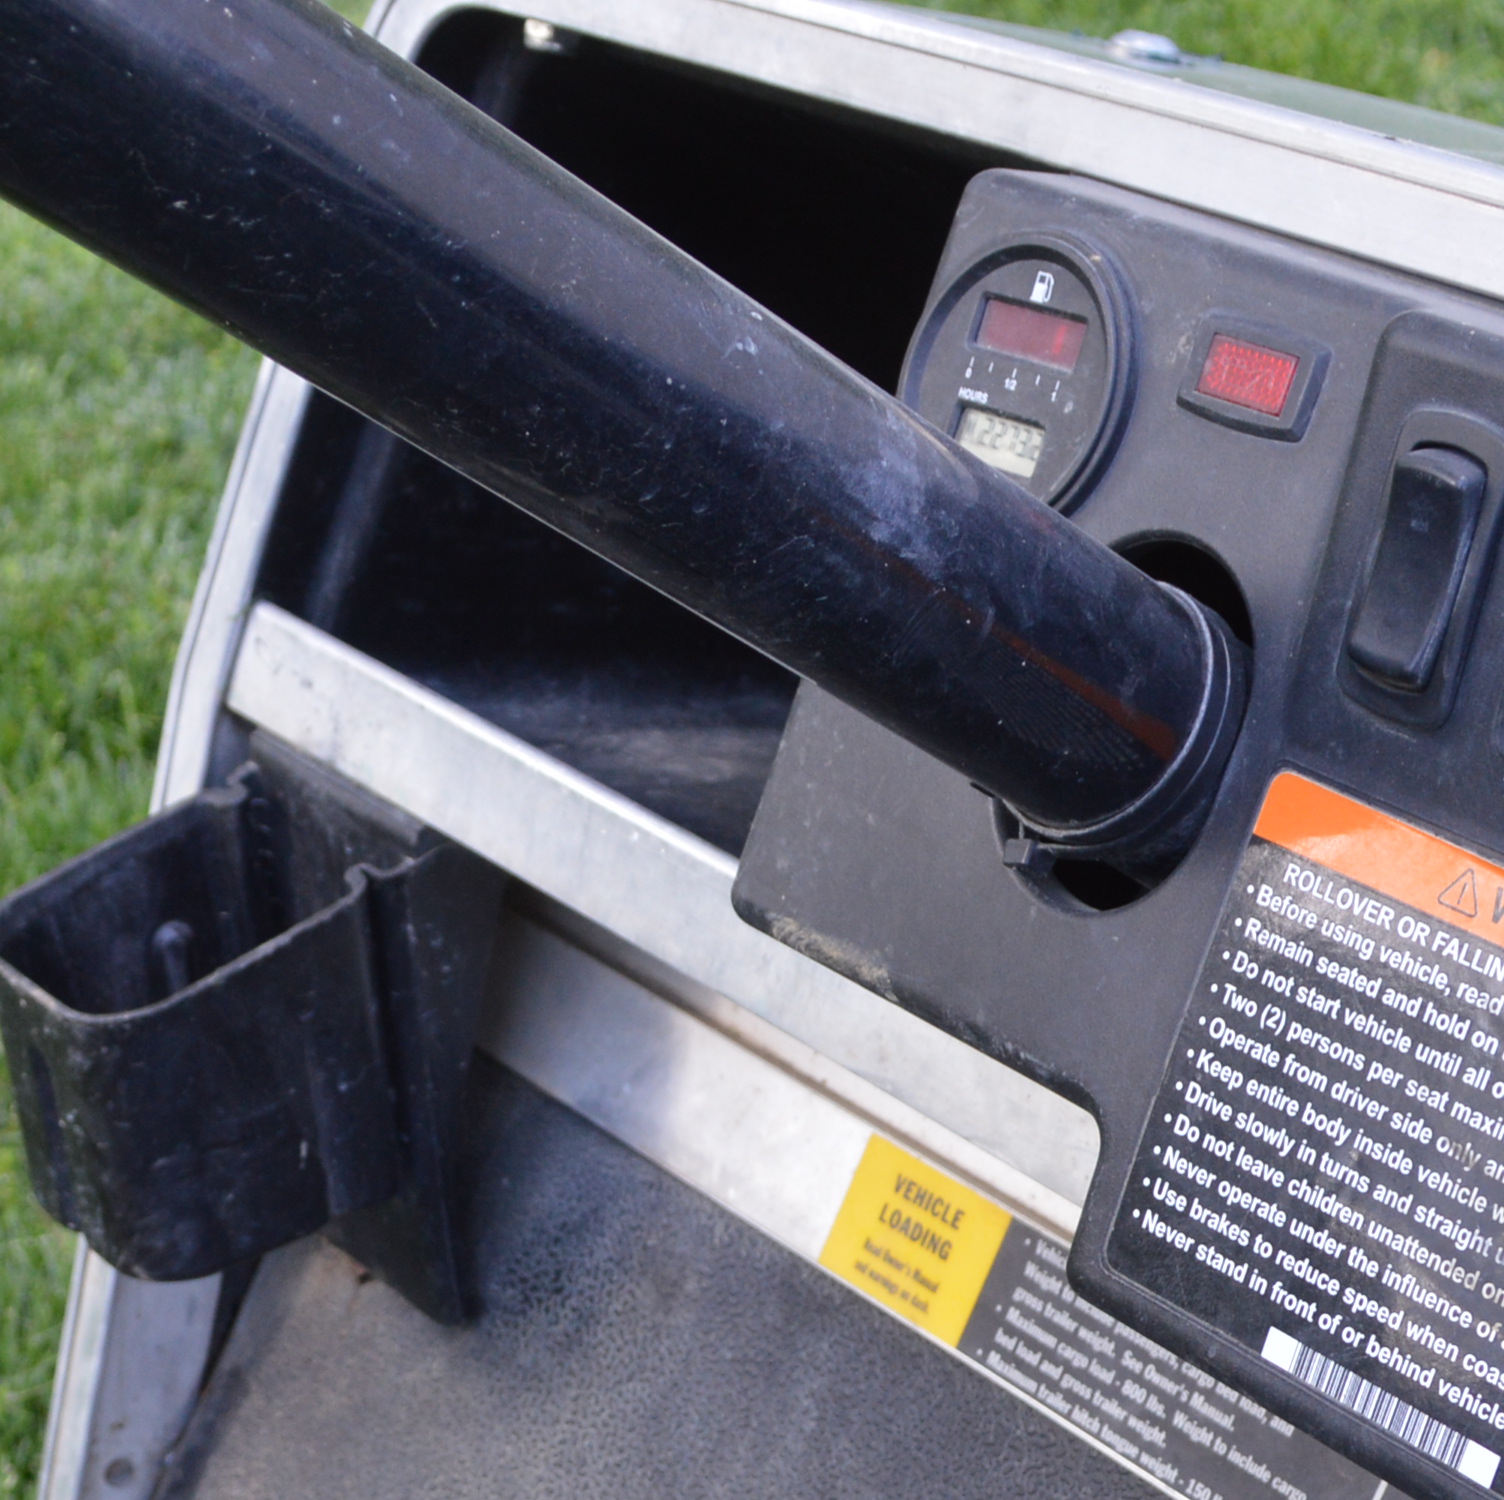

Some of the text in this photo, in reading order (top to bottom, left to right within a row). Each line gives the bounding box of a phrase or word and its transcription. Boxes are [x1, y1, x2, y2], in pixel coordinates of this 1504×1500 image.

[958, 387, 988, 403] HOURS
[1255, 883, 1317, 929] Before
[1320, 916, 1375, 960] using
[1379, 944, 1450, 996] vehicle,
[1455, 982, 1504, 1015] read
[1282, 862, 1395, 930] ROLLOVER
[1396, 915, 1430, 946] OR
[1222, 982, 1257, 1017] Two
[1259, 1003, 1286, 1034] (2)
[1285, 1020, 1365, 1070] persons
[1366, 1060, 1404, 1087] per
[1404, 1079, 1449, 1112] seat
[1231, 950, 1258, 979] Do
[1260, 968, 1294, 997] not
[1295, 985, 1341, 1019] start
[1344, 1007, 1411, 1053] vehicle
[1414, 1042, 1462, 1077] until
[1461, 1066, 1491, 1091] all
[1243, 917, 1313, 967] Remain
[1315, 956, 1382, 998] seated
[1381, 987, 1423, 1017] and
[1422, 1001, 1470, 1040] hold
[1470, 1030, 1498, 1055] on
[1195, 1048, 1243, 1090] Keep
[1245, 1078, 1299, 1116] entire
[1301, 1101, 1351, 1146] body
[1352, 1128, 1412, 1174] inside
[1417, 1164, 1487, 1212] vehicle
[1208, 1016, 1280, 1067] Operate
[1282, 1053, 1327, 1092] from
[1330, 1079, 1389, 1121] driver
[1389, 1111, 1432, 1144] side
[1435, 1135, 1481, 1171] only
[878, 1202, 952, 1261] LOADING
[894, 1173, 965, 1230] VEHICLE
[1173, 1113, 1200, 1142] Do
[1201, 1133, 1234, 1161] not
[1234, 1145, 1284, 1187] leave
[1287, 1178, 1364, 1230] children
[1366, 1220, 1480, 1290] unattended
[1184, 1080, 1232, 1121] Drive
[1234, 1111, 1295, 1156] slowly
[1296, 1138, 1316, 1165] in
[1318, 1151, 1370, 1192] turns
[1372, 1183, 1413, 1214] and
[1413, 1205, 1492, 1257] straight
[1141, 1208, 1195, 1252] Never
[1195, 1243, 1248, 1283] stand
[1248, 1268, 1267, 1295] in
[1269, 1280, 1317, 1322] front
[1317, 1313, 1343, 1334] of
[1341, 1326, 1365, 1347] or
[1364, 1333, 1435, 1388] behind
[1152, 1177, 1187, 1211] Use
[1188, 1197, 1250, 1246] brakes
[1252, 1233, 1272, 1258] to
[1274, 1249, 1340, 1295] reduce
[1342, 1287, 1404, 1330] speed
[1405, 1320, 1459, 1362] when
[1162, 1145, 1217, 1188] Never
[1217, 1180, 1286, 1227] operate
[1289, 1217, 1346, 1258] under
[1347, 1246, 1379, 1277] the
[1381, 1263, 1472, 1328] influence
[1476, 1320, 1502, 1342] of
[986, 1349, 1038, 1393] Maximum
[1036, 1383, 1072, 1414] trailer
[1070, 1404, 1100, 1433] hitch
[1099, 1423, 1139, 1458] tongue
[1139, 1451, 1178, 1483] weight
